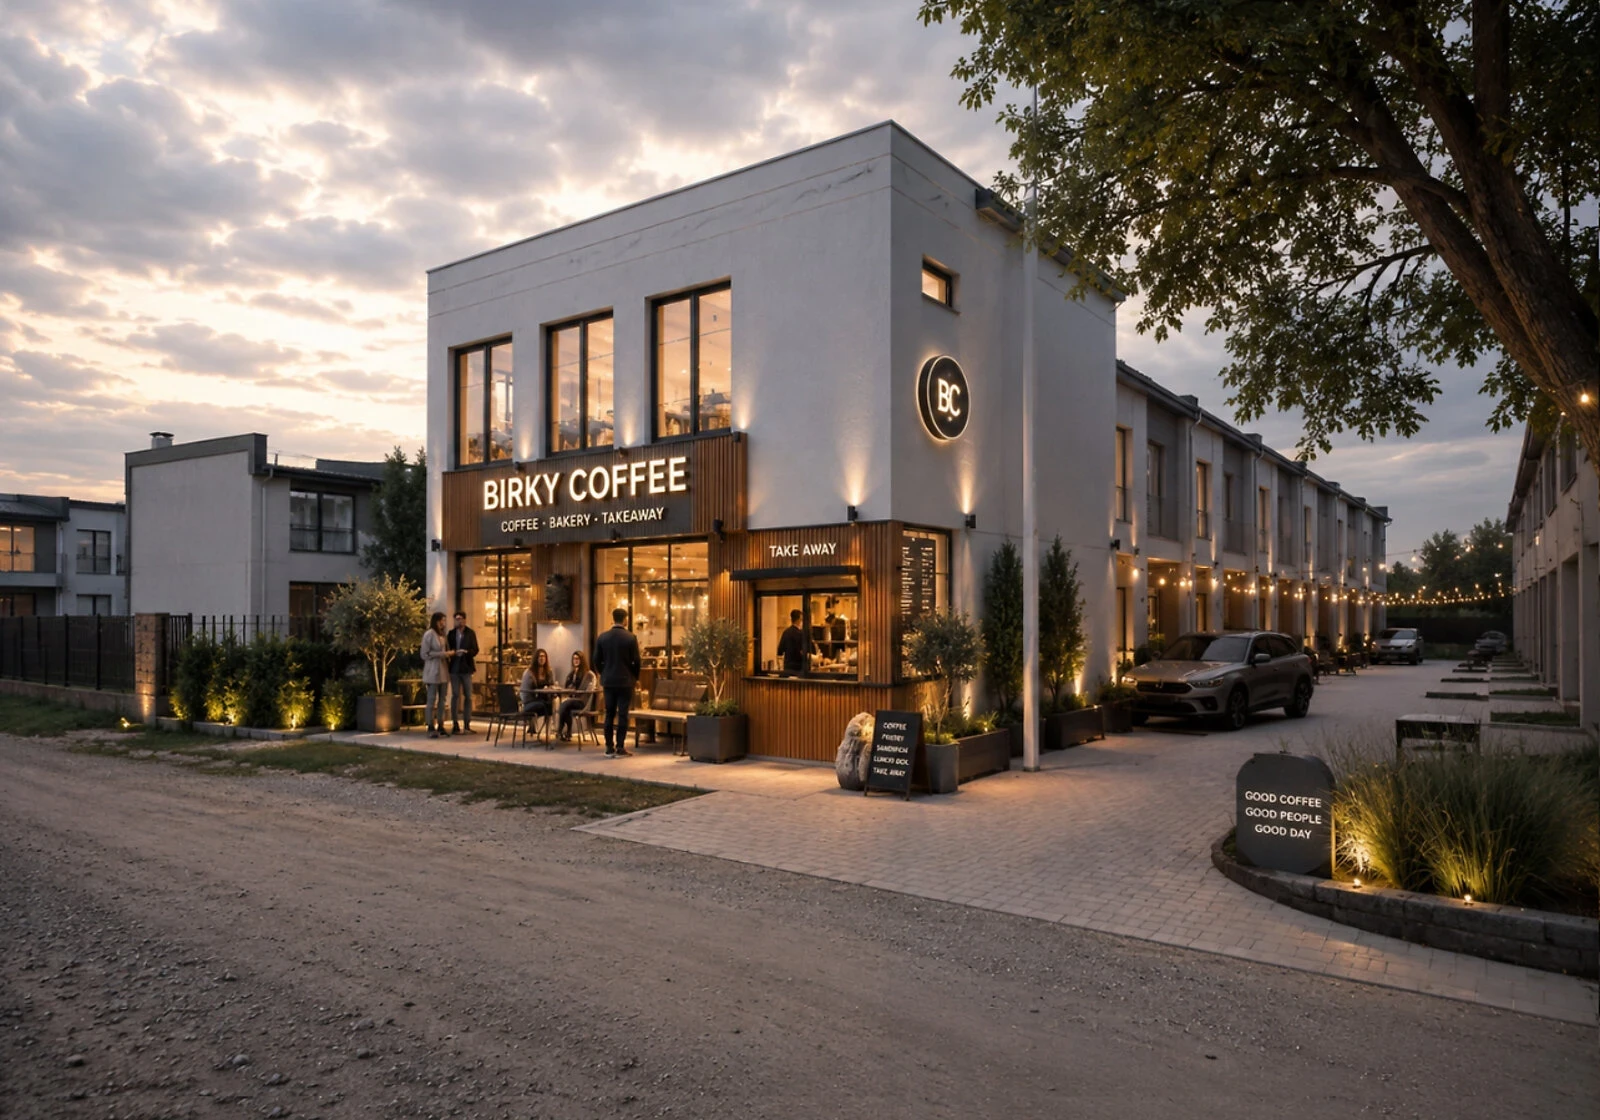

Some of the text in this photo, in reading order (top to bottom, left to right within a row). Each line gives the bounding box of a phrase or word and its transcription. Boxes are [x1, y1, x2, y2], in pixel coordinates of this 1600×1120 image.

[483, 456, 687, 511] BIRKY COFFEE
[501, 507, 664, 532] COFFEE BAKERY TAKEAWAY
[769, 542, 837, 558] TAKE AWAY
[1245, 791, 1322, 808] GOOD COFFEE
[1245, 807, 1322, 824] GOOD PEOPLE
[1255, 824, 1312, 839] GOOD DAY
